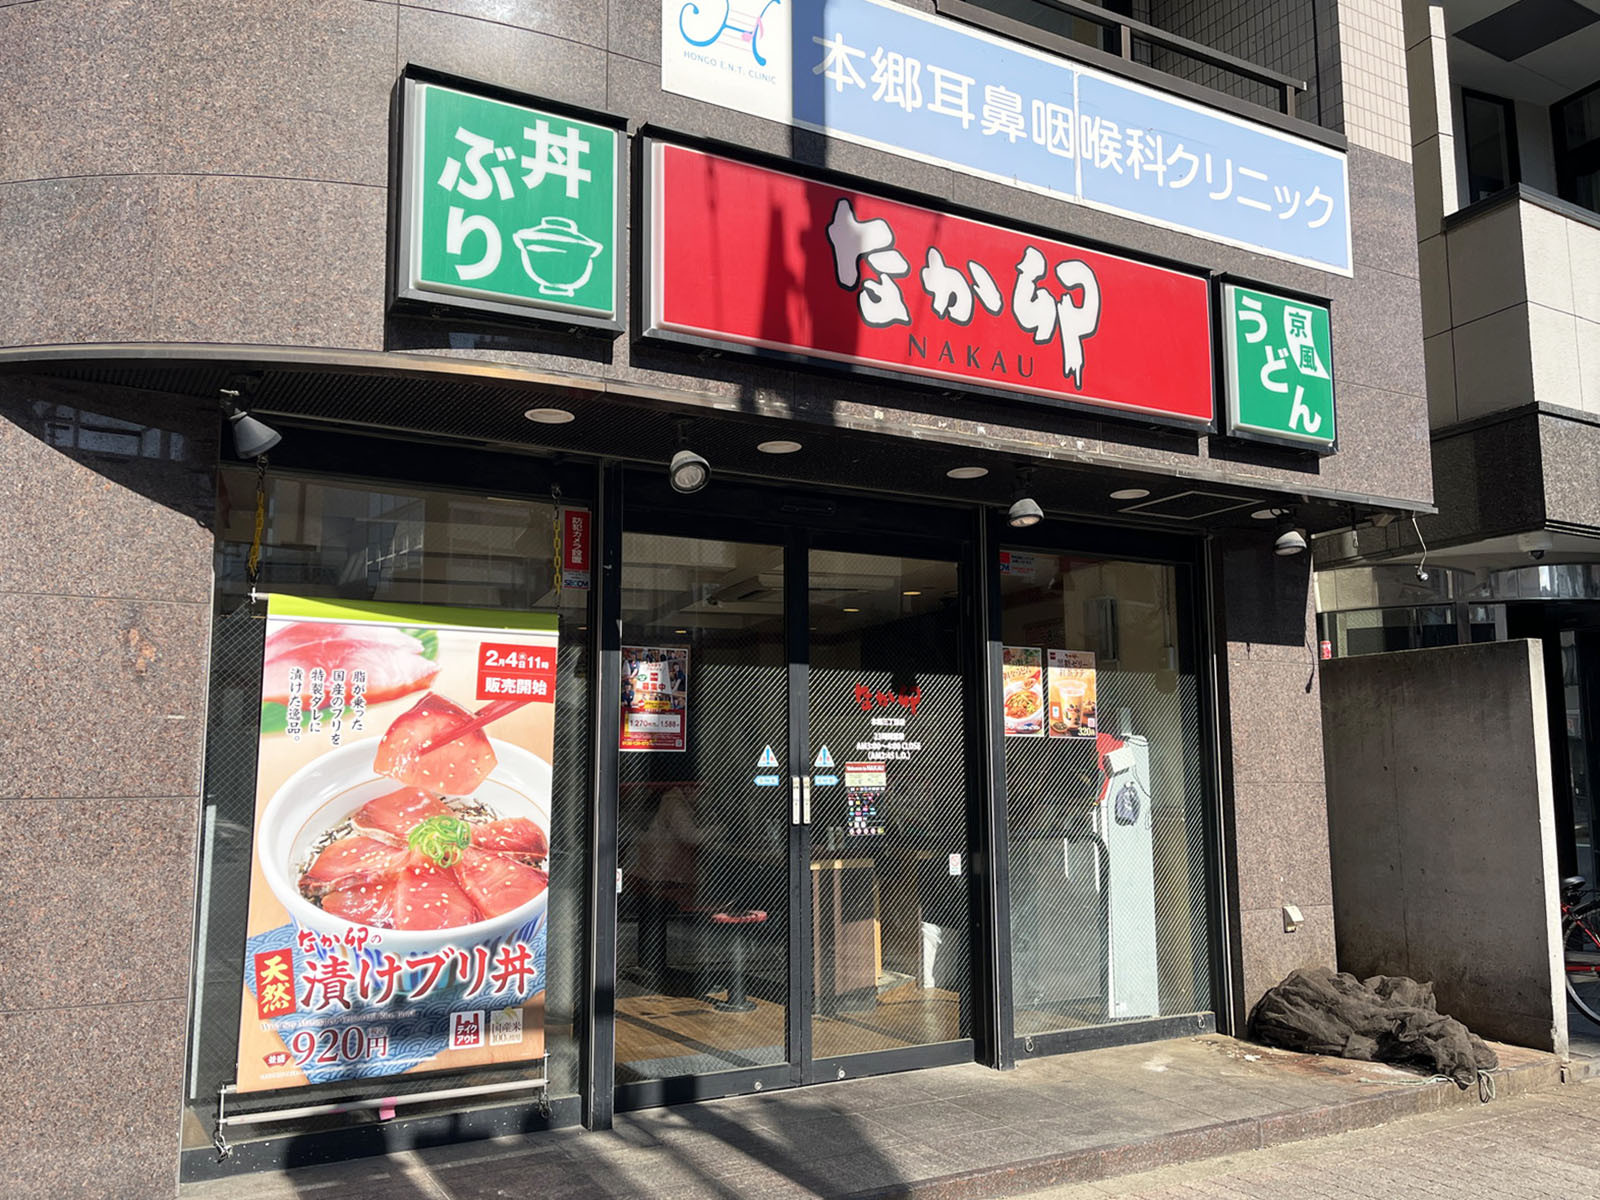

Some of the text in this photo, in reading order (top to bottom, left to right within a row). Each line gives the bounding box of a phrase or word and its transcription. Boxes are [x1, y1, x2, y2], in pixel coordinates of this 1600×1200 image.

[747, 69, 777, 85] CLINIC
[812, 32, 1335, 229] 本郷耳鼻咽喉科クリニック
[826, 198, 1101, 390] なか卯
[908, 333, 1034, 378] NAKAU
[1238, 295, 1322, 433] うどん
[1289, 312, 1317, 372] 京風
[310, 669, 324, 732] 特製ダレに
[352, 670, 366, 731] 脂が乗った
[485, 677, 547, 696] 販売開始
[260, 955, 291, 1013] 天然
[299, 944, 536, 1012] 漬けブリ丼
[292, 1026, 388, 1067] 920円
[457, 1024, 478, 1035] テイク
[457, 1035, 478, 1045] アウト
